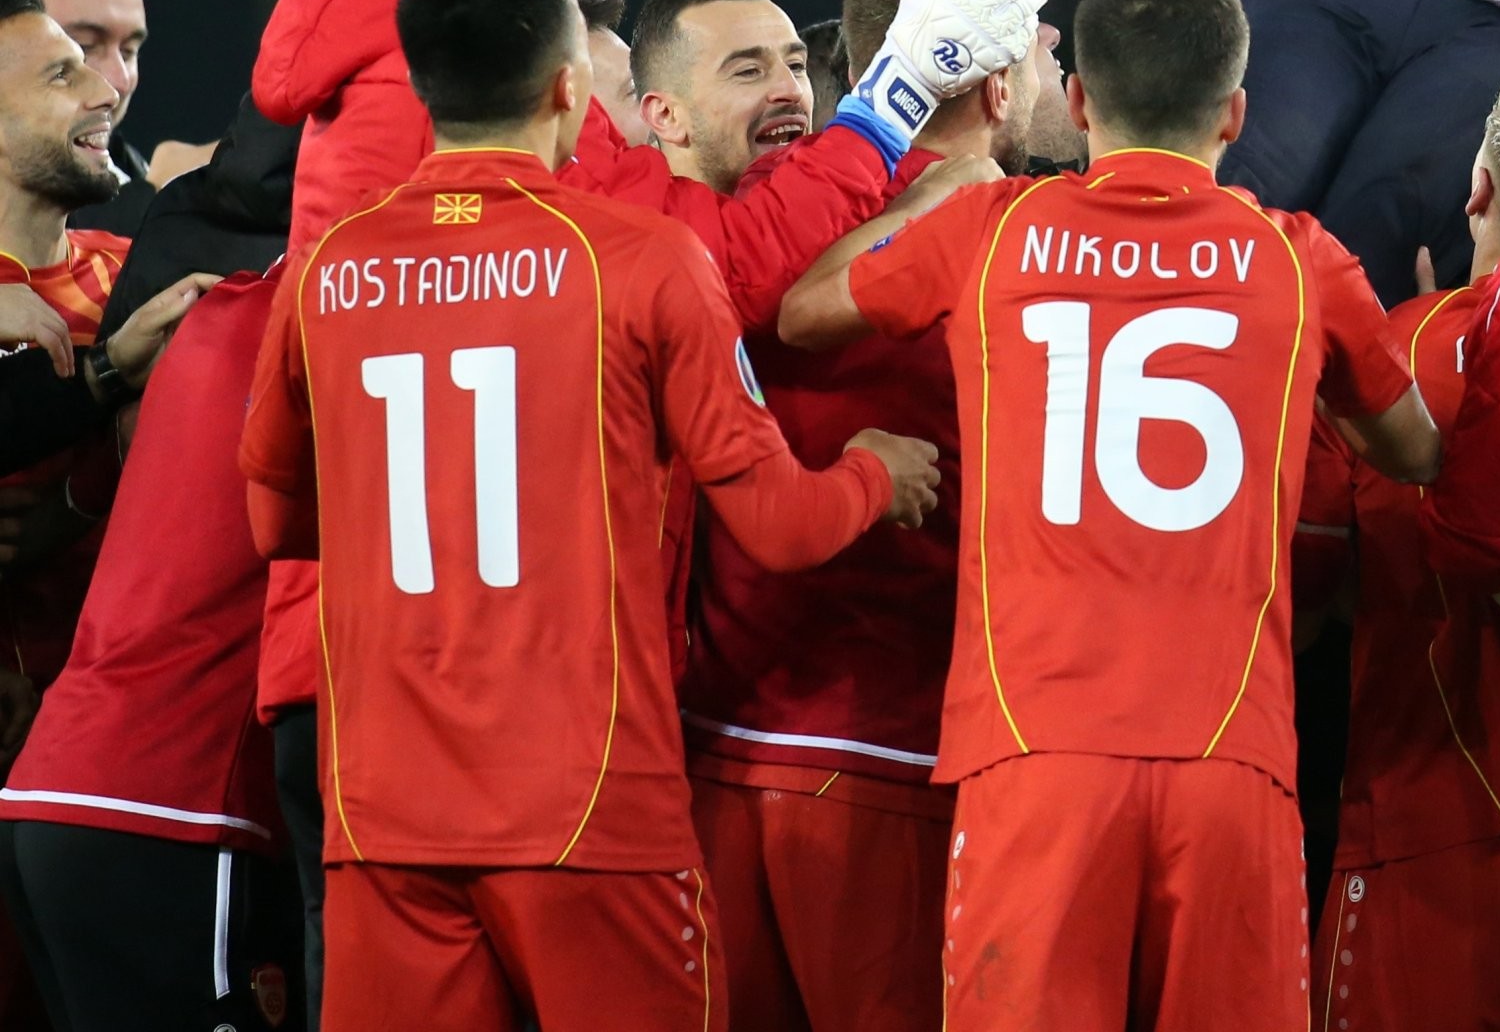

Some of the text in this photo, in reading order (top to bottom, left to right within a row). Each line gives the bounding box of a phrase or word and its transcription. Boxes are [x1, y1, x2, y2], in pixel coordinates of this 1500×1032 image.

[890, 87, 925, 124] ANGELA
[320, 247, 568, 314] KOSTADINOV
[1020, 225, 1255, 283] NIKOLOV
[1021, 300, 1244, 532] 16
[361, 345, 519, 594] 11
